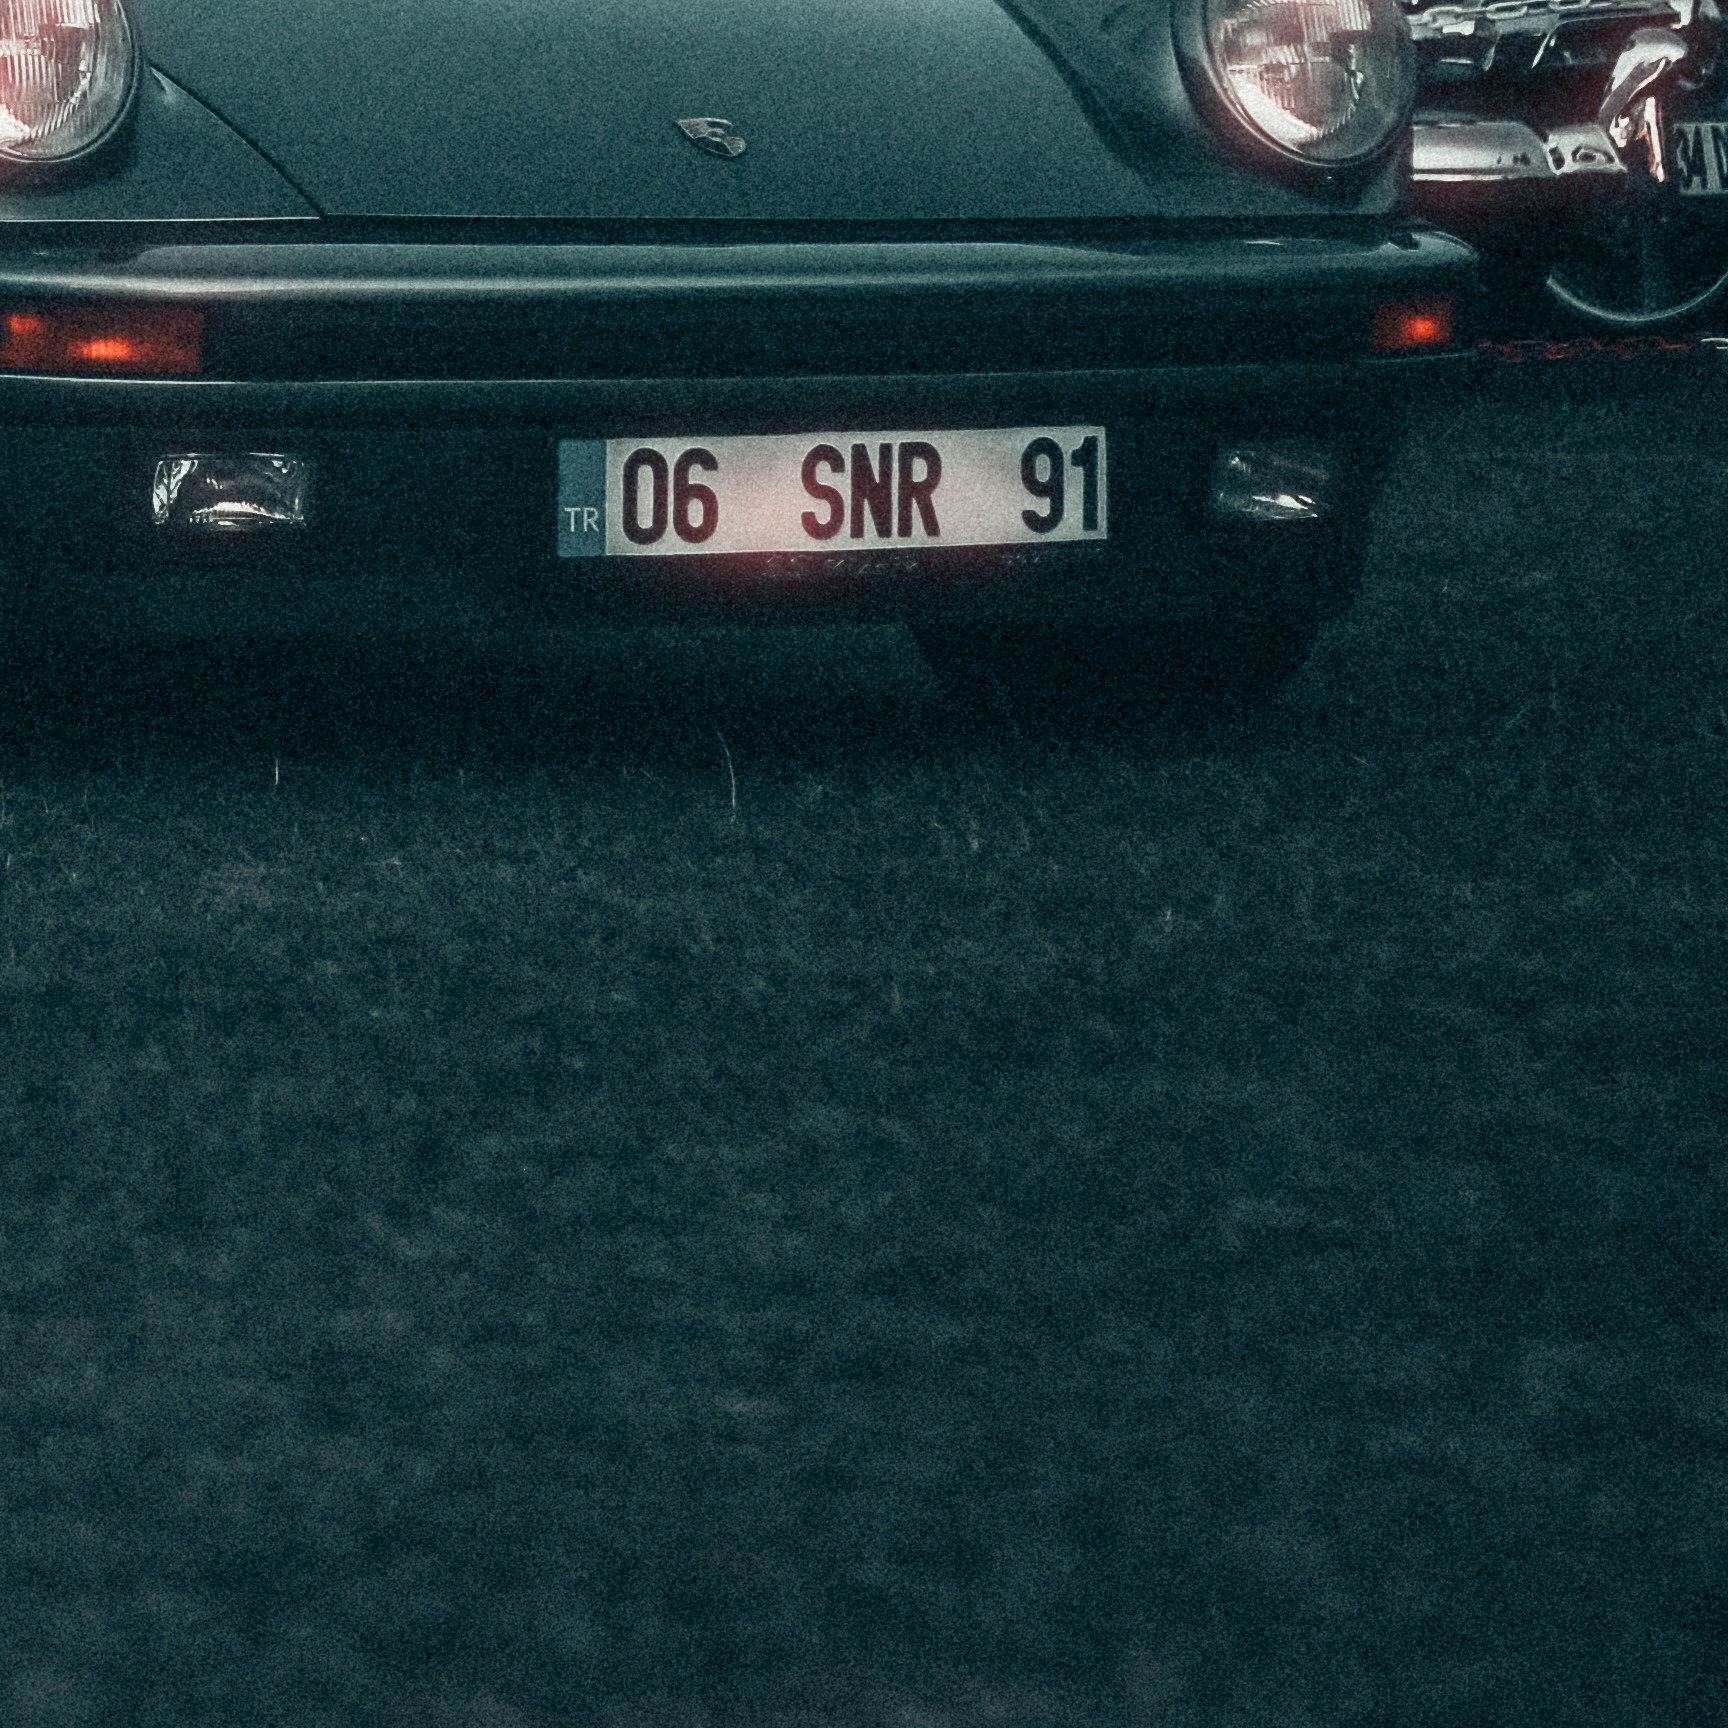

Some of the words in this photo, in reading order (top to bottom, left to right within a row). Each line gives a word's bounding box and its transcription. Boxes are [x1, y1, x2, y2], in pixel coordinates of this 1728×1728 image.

[564, 507, 599, 532] TR
[622, 447, 718, 544] 06
[801, 442, 942, 540] SNR
[1021, 436, 1098, 534] 91
